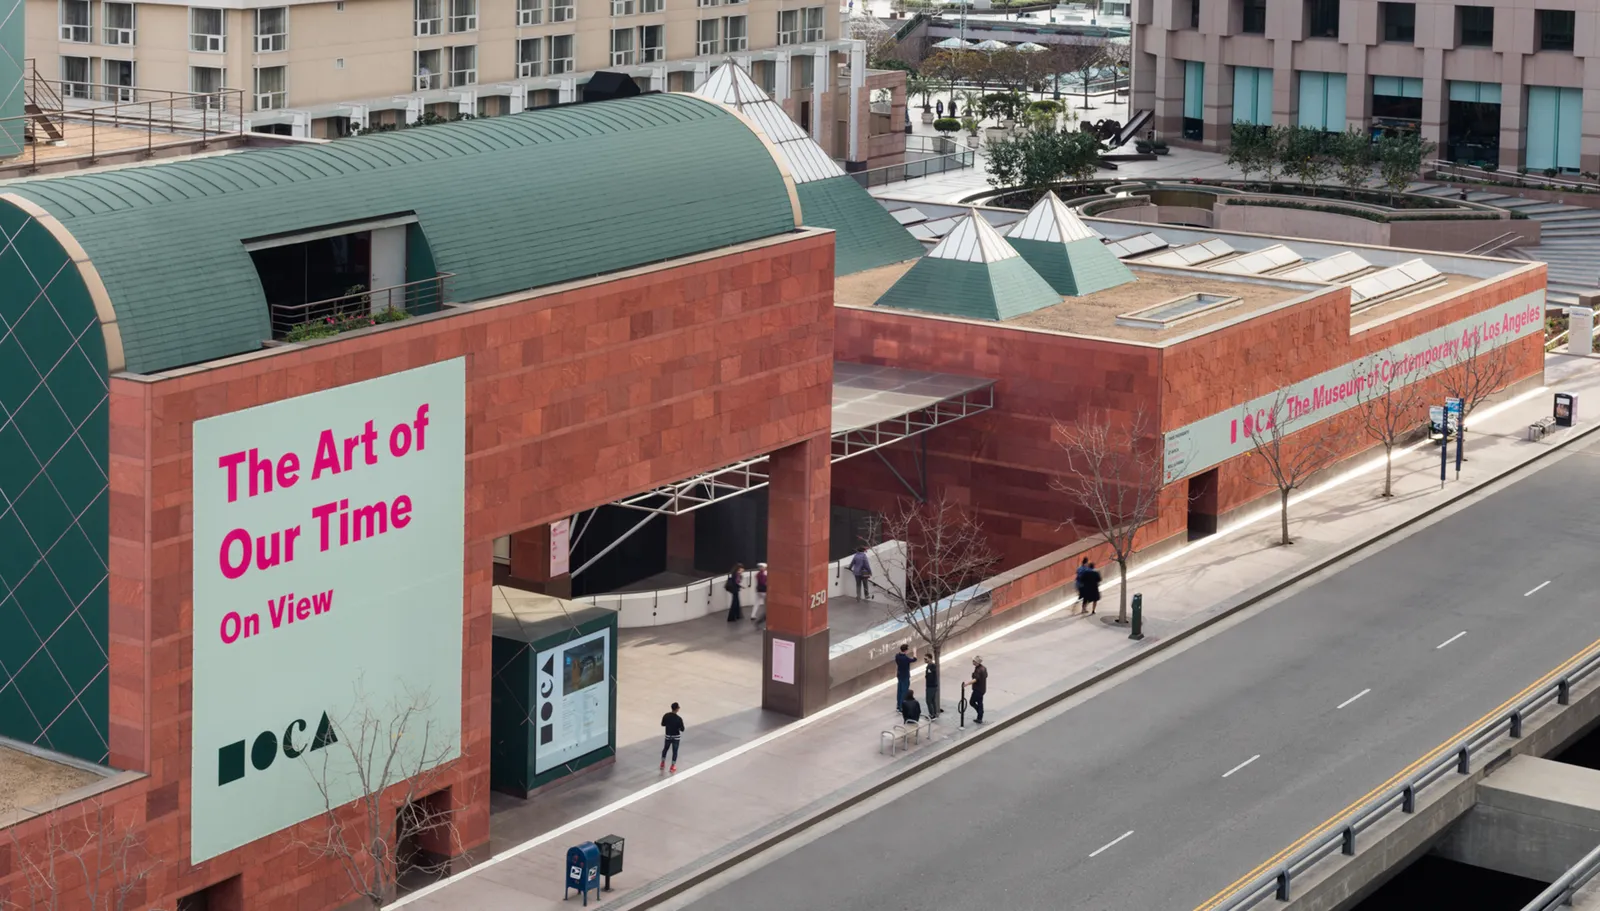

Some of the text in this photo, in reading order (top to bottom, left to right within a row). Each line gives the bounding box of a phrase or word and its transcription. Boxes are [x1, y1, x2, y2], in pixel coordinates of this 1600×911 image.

[1286, 395, 1310, 420] The
[1312, 375, 1365, 411] Museum
[1367, 363, 1380, 389] of
[1381, 337, 1460, 382] Contemporary
[1483, 320, 1500, 342] Los
[1502, 303, 1540, 334] Angeles
[218, 403, 429, 503] The Art of
[219, 494, 413, 579] Our Time
[220, 588, 334, 644] On View
[810, 589, 827, 609] 250
